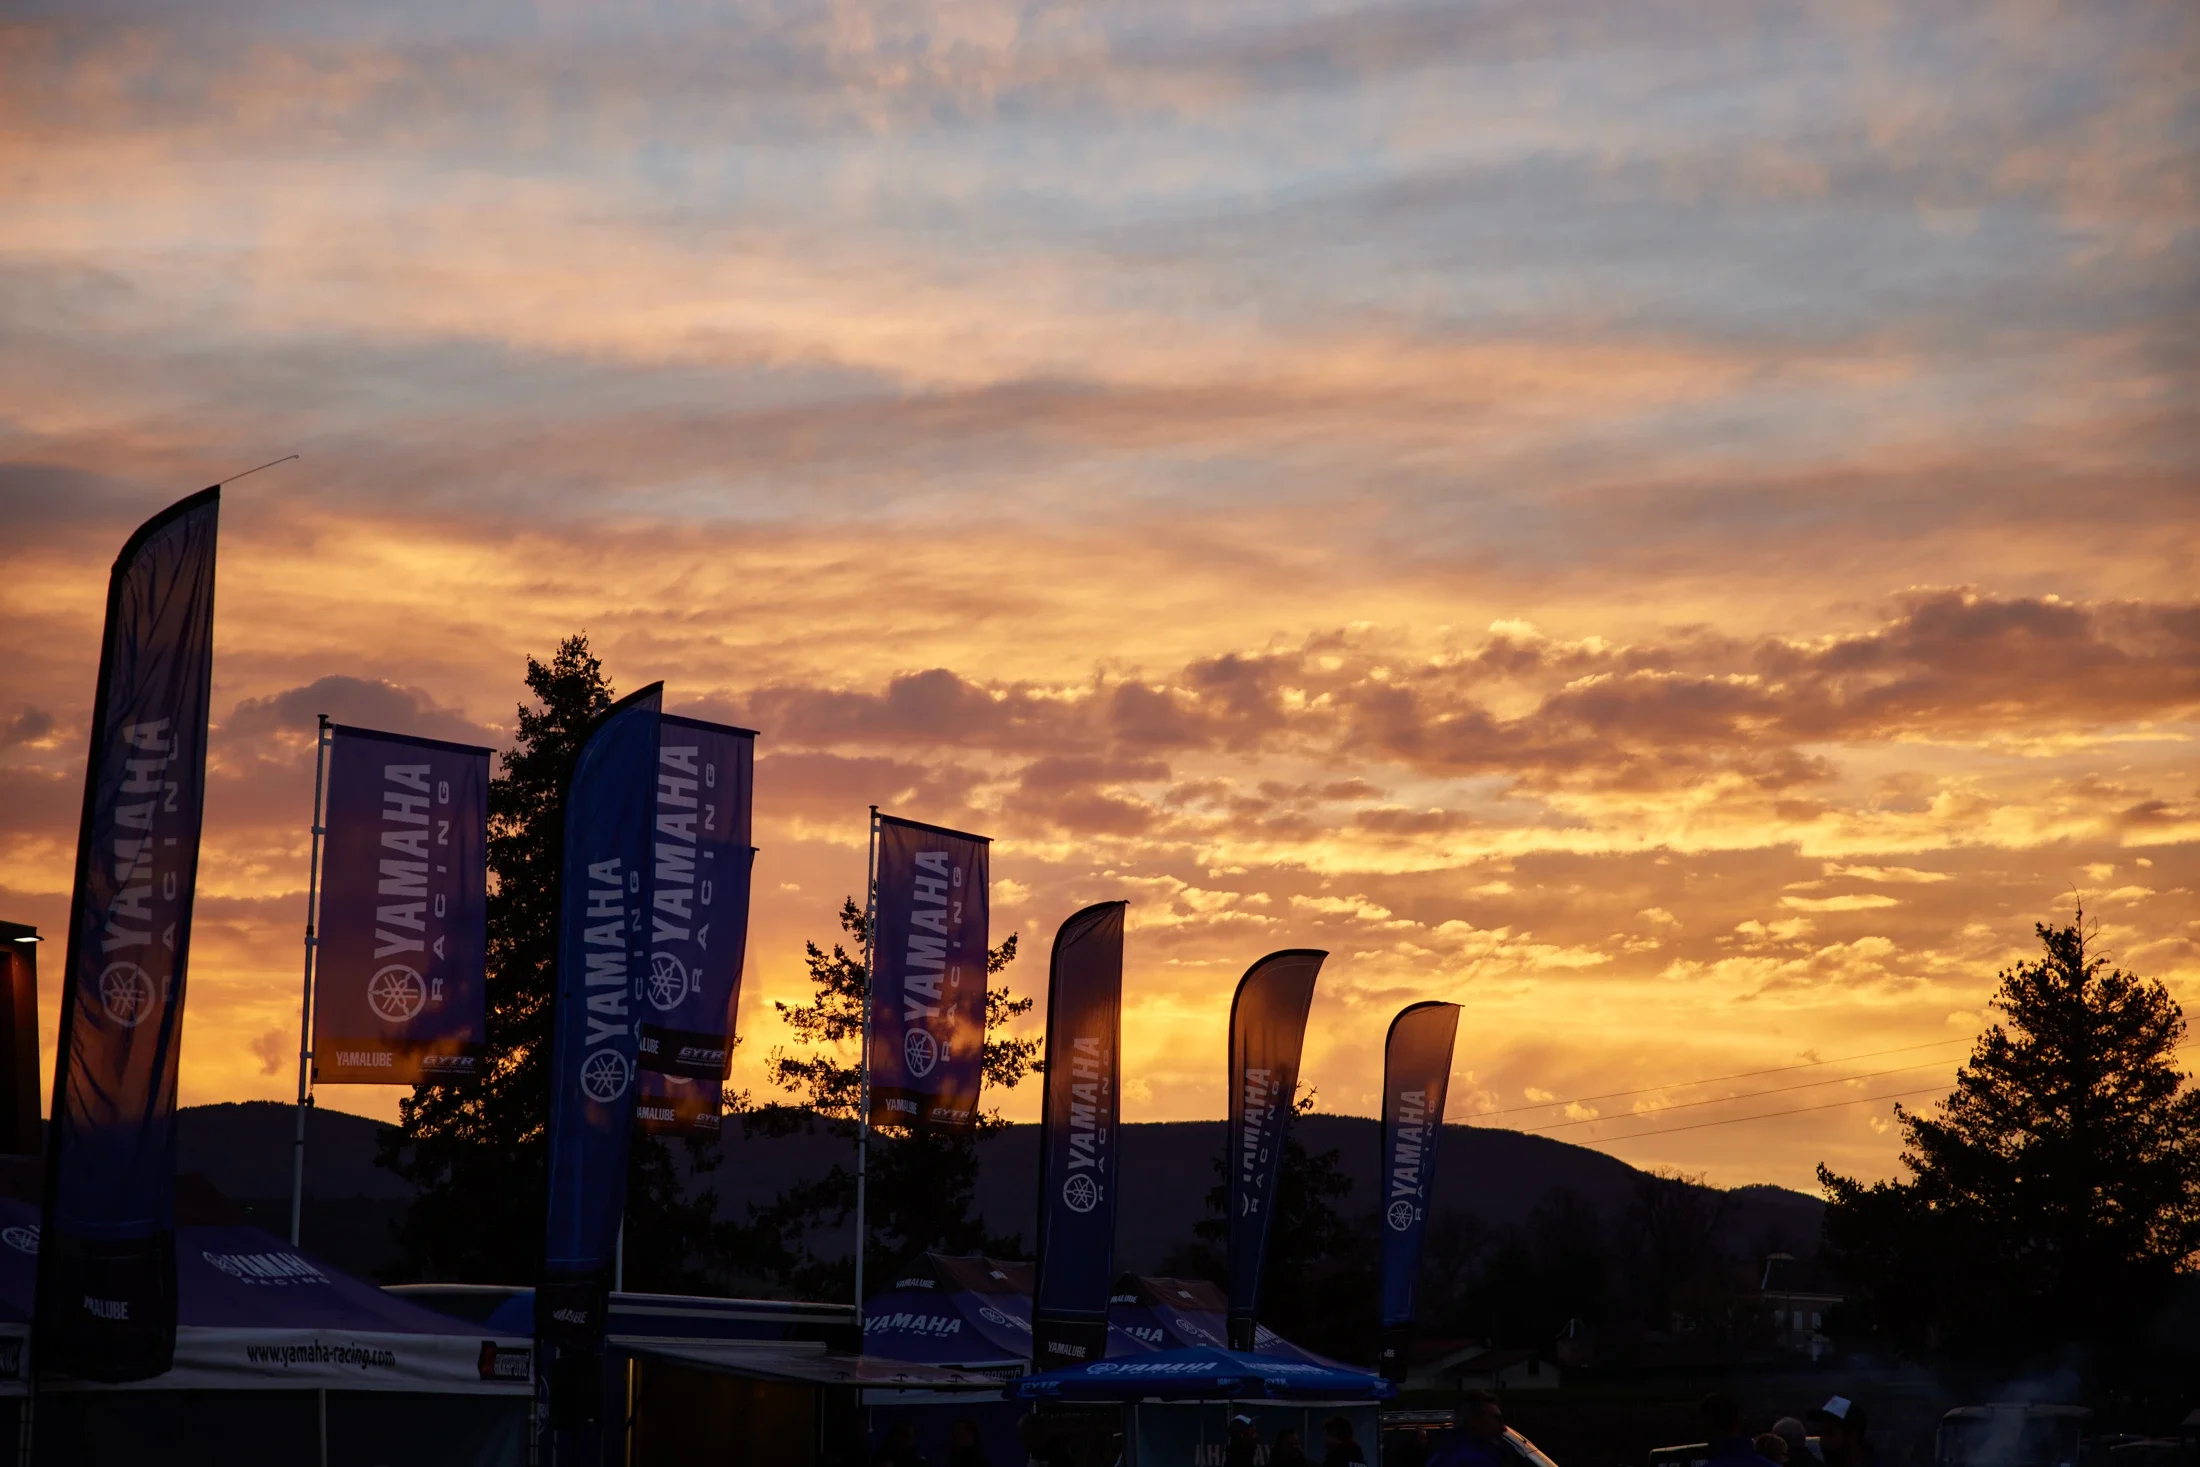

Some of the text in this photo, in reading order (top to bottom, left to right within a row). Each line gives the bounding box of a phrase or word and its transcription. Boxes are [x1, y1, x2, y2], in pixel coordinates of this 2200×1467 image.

[101, 716, 171, 953] YAMAHA
[373, 764, 431, 960] YAMAHA
[431, 780, 450, 1002] RACING
[651, 745, 699, 943] YAMAHA
[691, 762, 716, 993] RACING
[584, 857, 629, 1047] YAMAHA
[904, 850, 949, 1022] YAMAHA
[940, 866, 962, 1062] RACING
[335, 1051, 393, 1067] YAMALUBE
[422, 1056, 475, 1066] GYTR
[1067, 1037, 1101, 1169] YAMAHA
[1250, 1080, 1280, 1213] RACING
[1391, 1090, 1426, 1198] YAMAHA
[221, 1252, 328, 1277] YAMAHA
[863, 1312, 962, 1333] YAMAHA
[896, 1277, 936, 1289] YAMALUBE
[247, 1339, 396, 1369] www.yamaha-racing.com
[1048, 1340, 1087, 1359] YAMALUBE
[1118, 1362, 1218, 1372] YAMAHA
